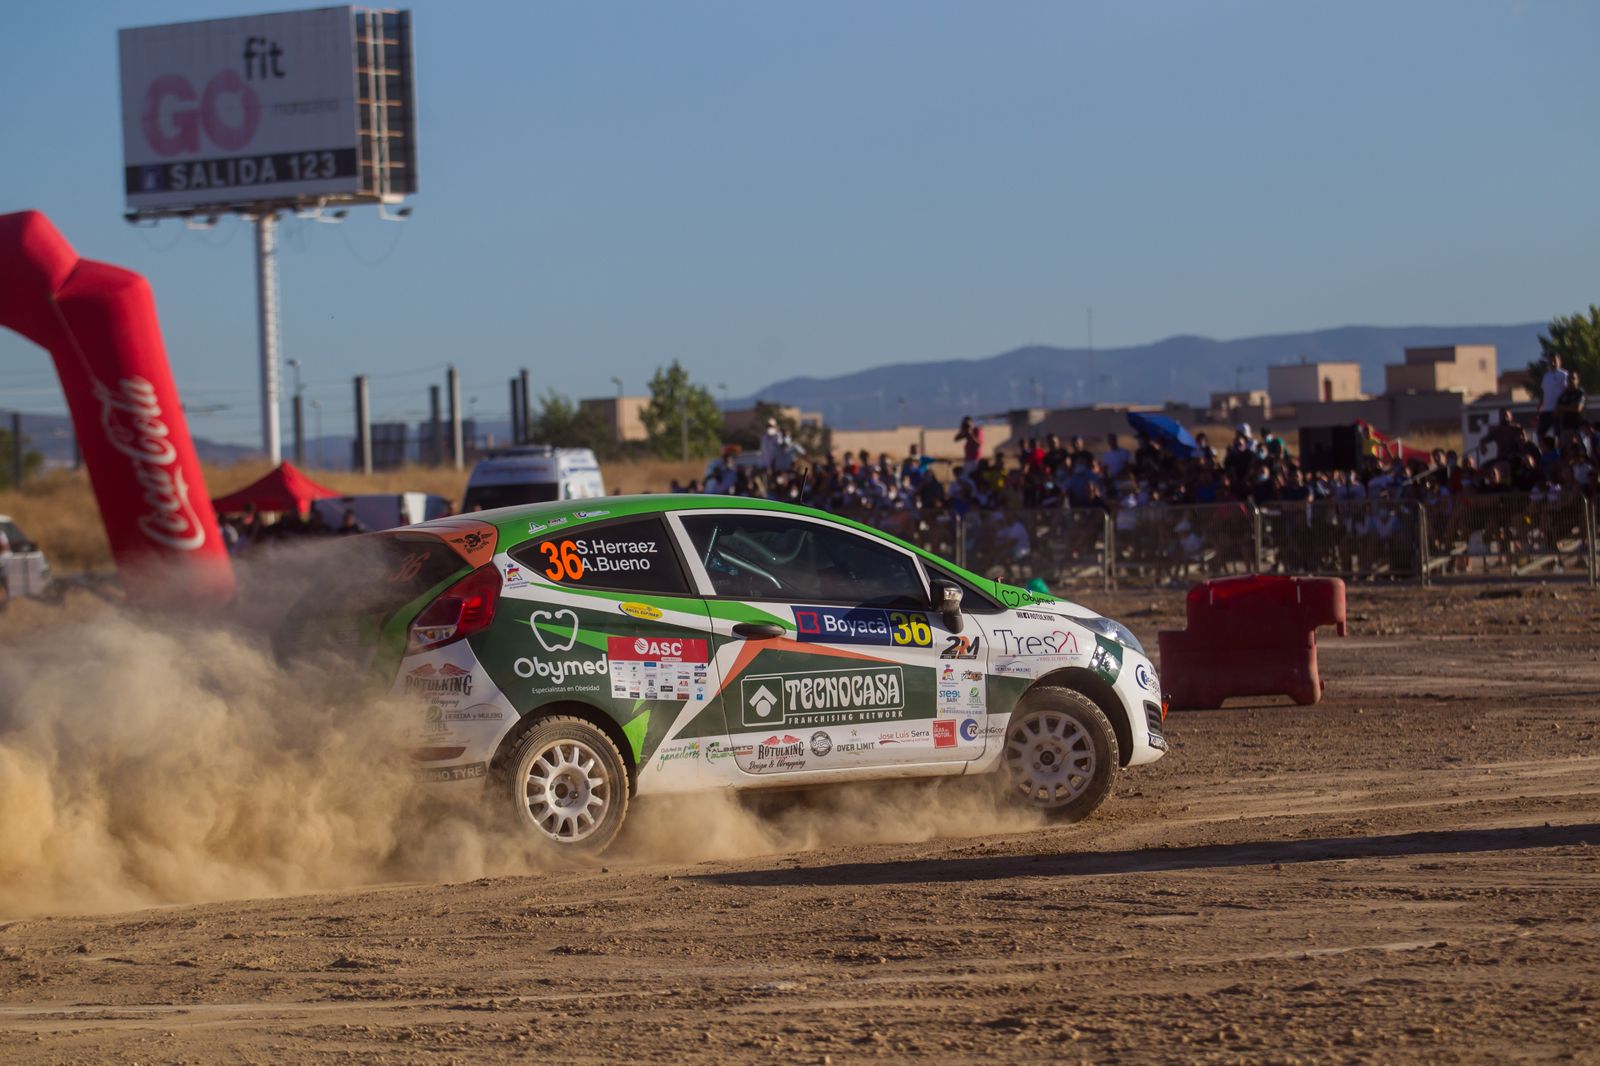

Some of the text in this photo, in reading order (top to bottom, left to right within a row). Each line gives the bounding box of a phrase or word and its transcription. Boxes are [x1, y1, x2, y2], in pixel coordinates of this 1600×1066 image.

[242, 37, 286, 80] fit
[142, 68, 263, 157] GO
[170, 152, 337, 190] SALIDA 123
[92, 373, 206, 551] Coca-Cola
[576, 540, 657, 555] S.Herraez
[540, 540, 584, 582] 36
[582, 557, 650, 572] A.Bueno
[889, 612, 933, 646] 36
[649, 641, 683, 656] ASC
[513, 653, 608, 684] Obymed
[531, 686, 567, 695] Especialistas
[785, 673, 900, 711] TECNOCASA
[788, 711, 903, 725] FRANCHISING NETWORK
[911, 730, 930, 738] Serra
[712, 745, 753, 753] ALBERTO
[757, 741, 805, 760] ROTULKING
[836, 742, 875, 753] OVER LIMIT
[453, 766, 482, 779] TYRE
